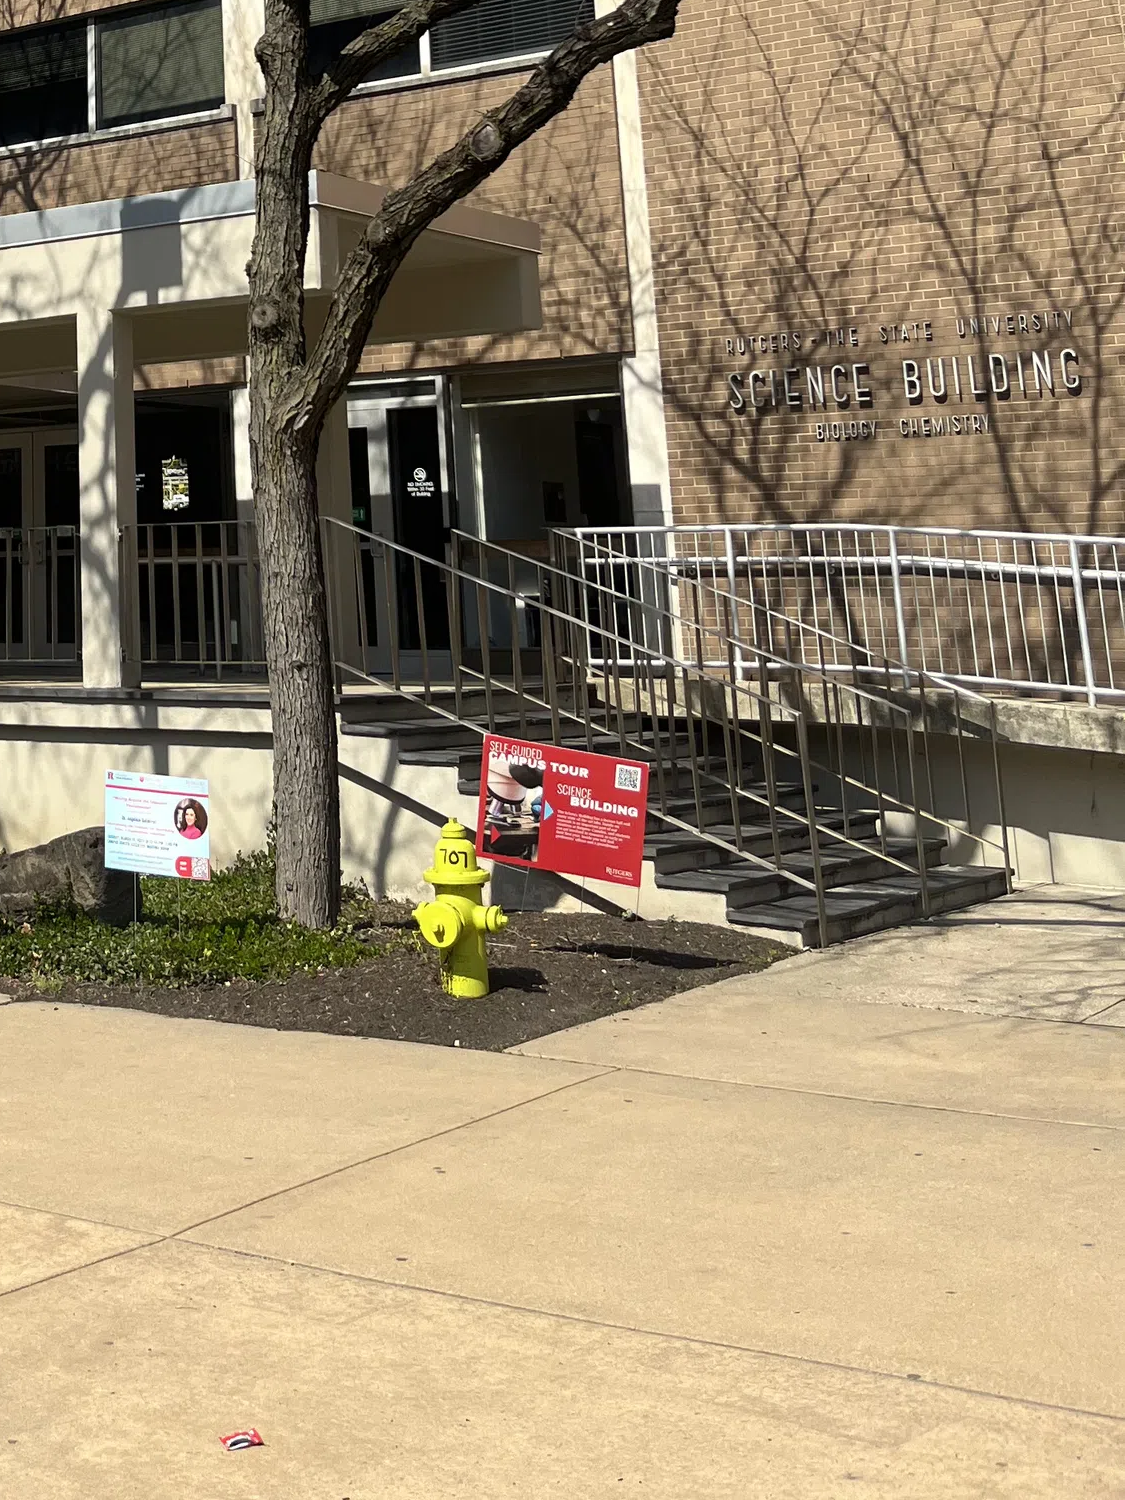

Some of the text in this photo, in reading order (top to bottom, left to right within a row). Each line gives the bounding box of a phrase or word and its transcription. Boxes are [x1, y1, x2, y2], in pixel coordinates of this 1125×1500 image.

[726, 332, 802, 355] RUTGERS
[826, 327, 858, 346] THE
[879, 321, 932, 343] STATE
[955, 310, 1073, 338] UNIVERSITY
[728, 349, 1080, 409] SCIENCE BUILDING
[816, 414, 989, 441] BIOLOGY CHEMISTRY
[489, 740, 543, 760] SELF-GUIDED
[488, 751, 589, 778] CAMPUS TOUR
[557, 783, 592, 800] SCIENCE
[570, 796, 638, 818] BUILDING
[439, 848, 468, 869] 707
[606, 866, 632, 878] RUTGERS
